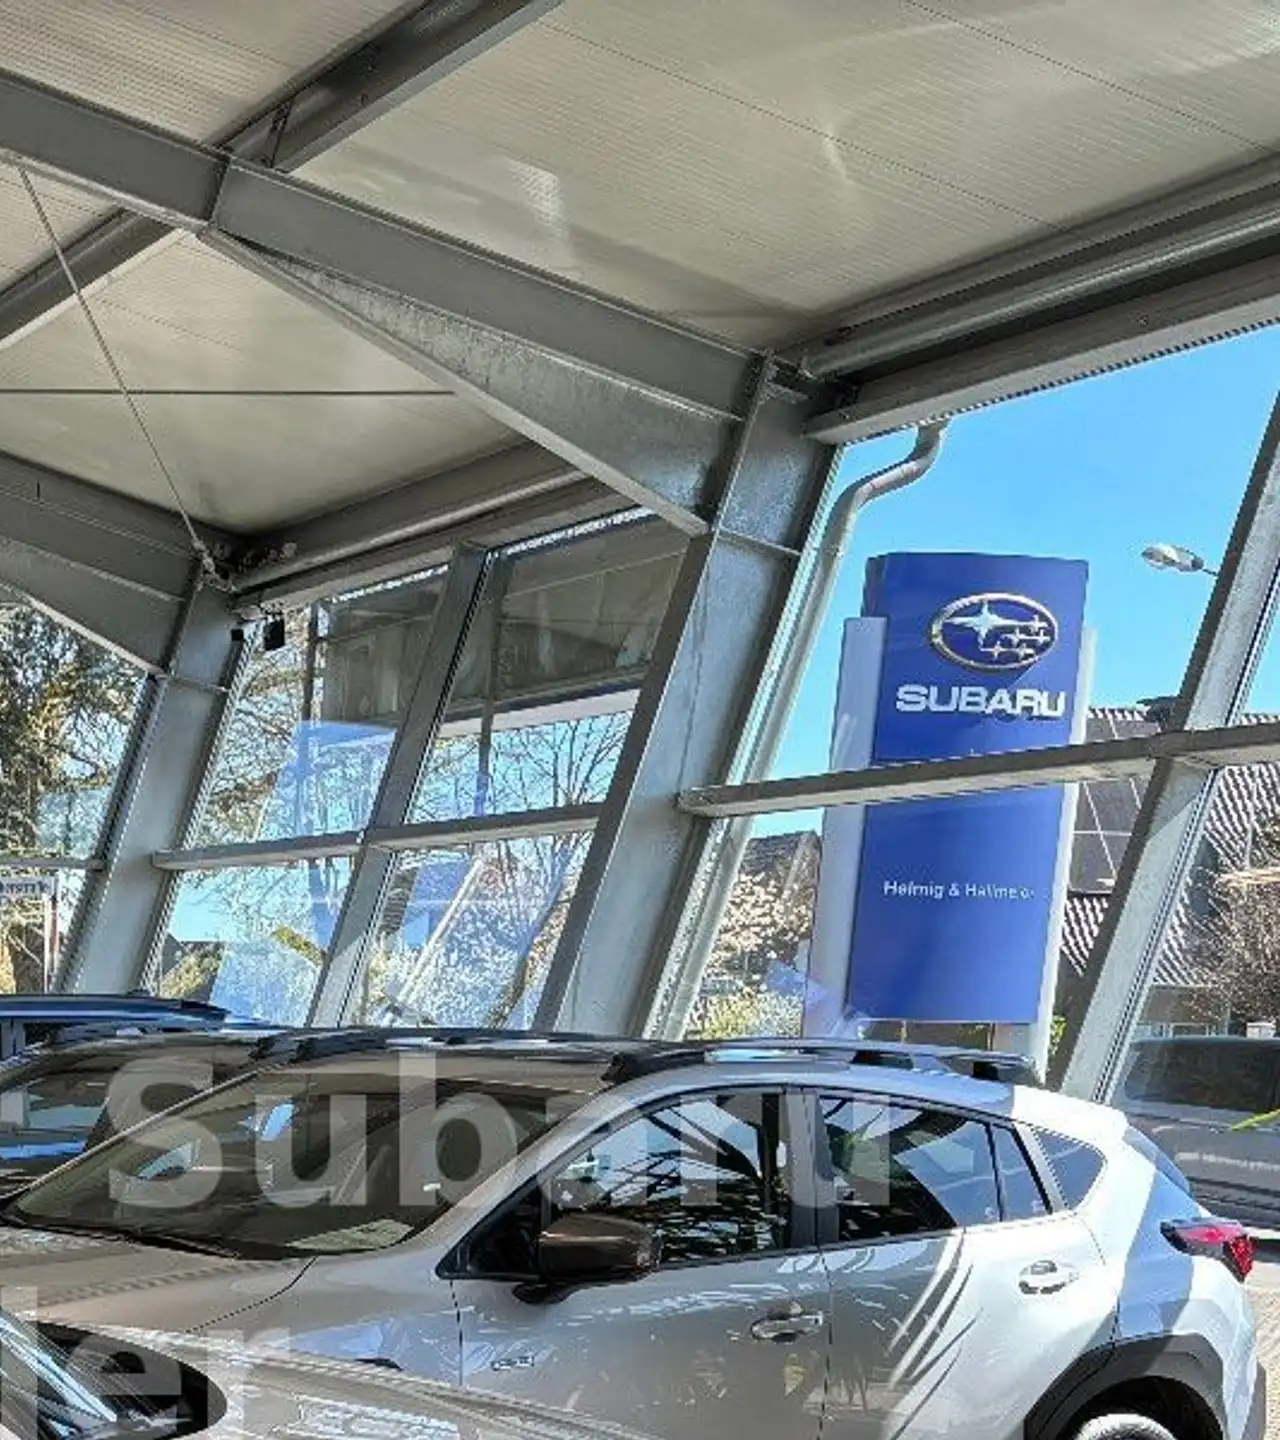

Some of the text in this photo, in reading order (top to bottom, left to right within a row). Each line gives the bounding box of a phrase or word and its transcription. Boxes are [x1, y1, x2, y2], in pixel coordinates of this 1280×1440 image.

[896, 684, 1066, 717] SUBARU
[883, 880, 1035, 899] Helmig & Hallmee
